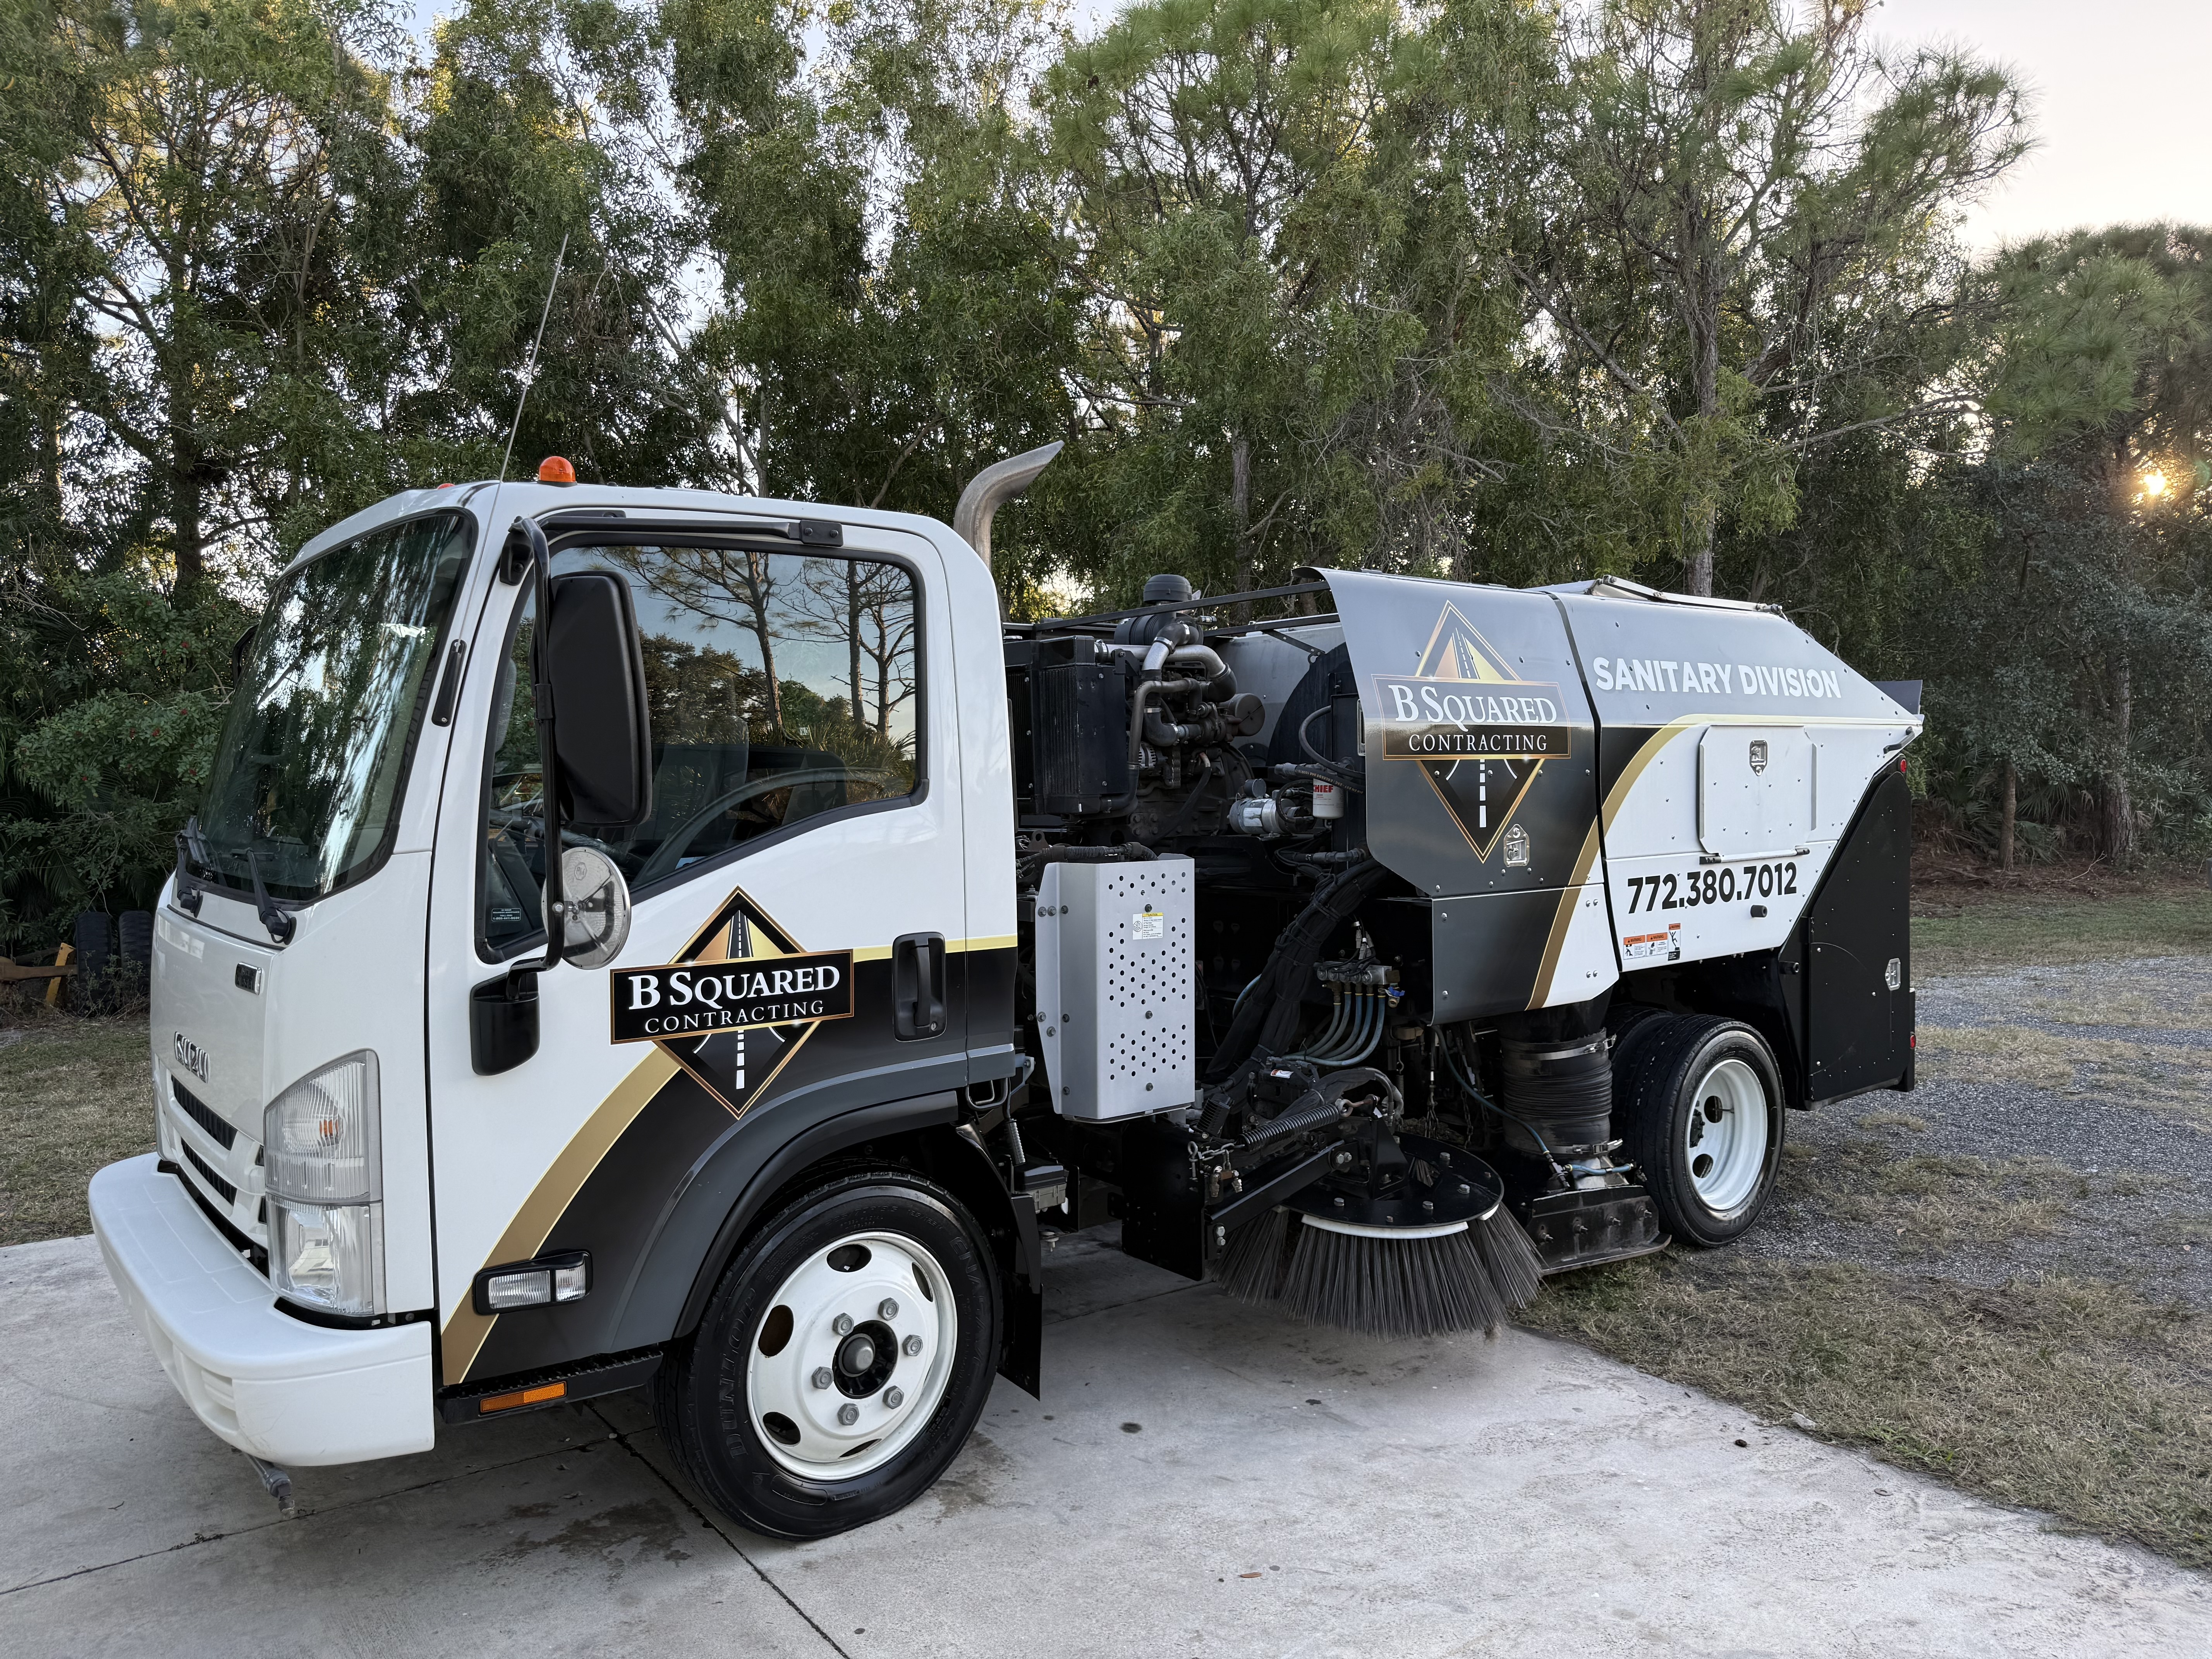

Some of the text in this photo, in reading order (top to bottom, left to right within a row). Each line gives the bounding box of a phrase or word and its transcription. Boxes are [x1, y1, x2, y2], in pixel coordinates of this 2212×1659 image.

[1593, 657, 1841, 698] SANITARY DIVISION
[1388, 685, 1557, 732] B SQUARED
[1409, 734, 1547, 751] CONTRACTING
[1628, 862, 1797, 914] 772.380.7012
[629, 966, 840, 1010] B SQUARED
[645, 1000, 824, 1033] CONTRACTING
[719, 1288, 757, 1458] DUNLOP
